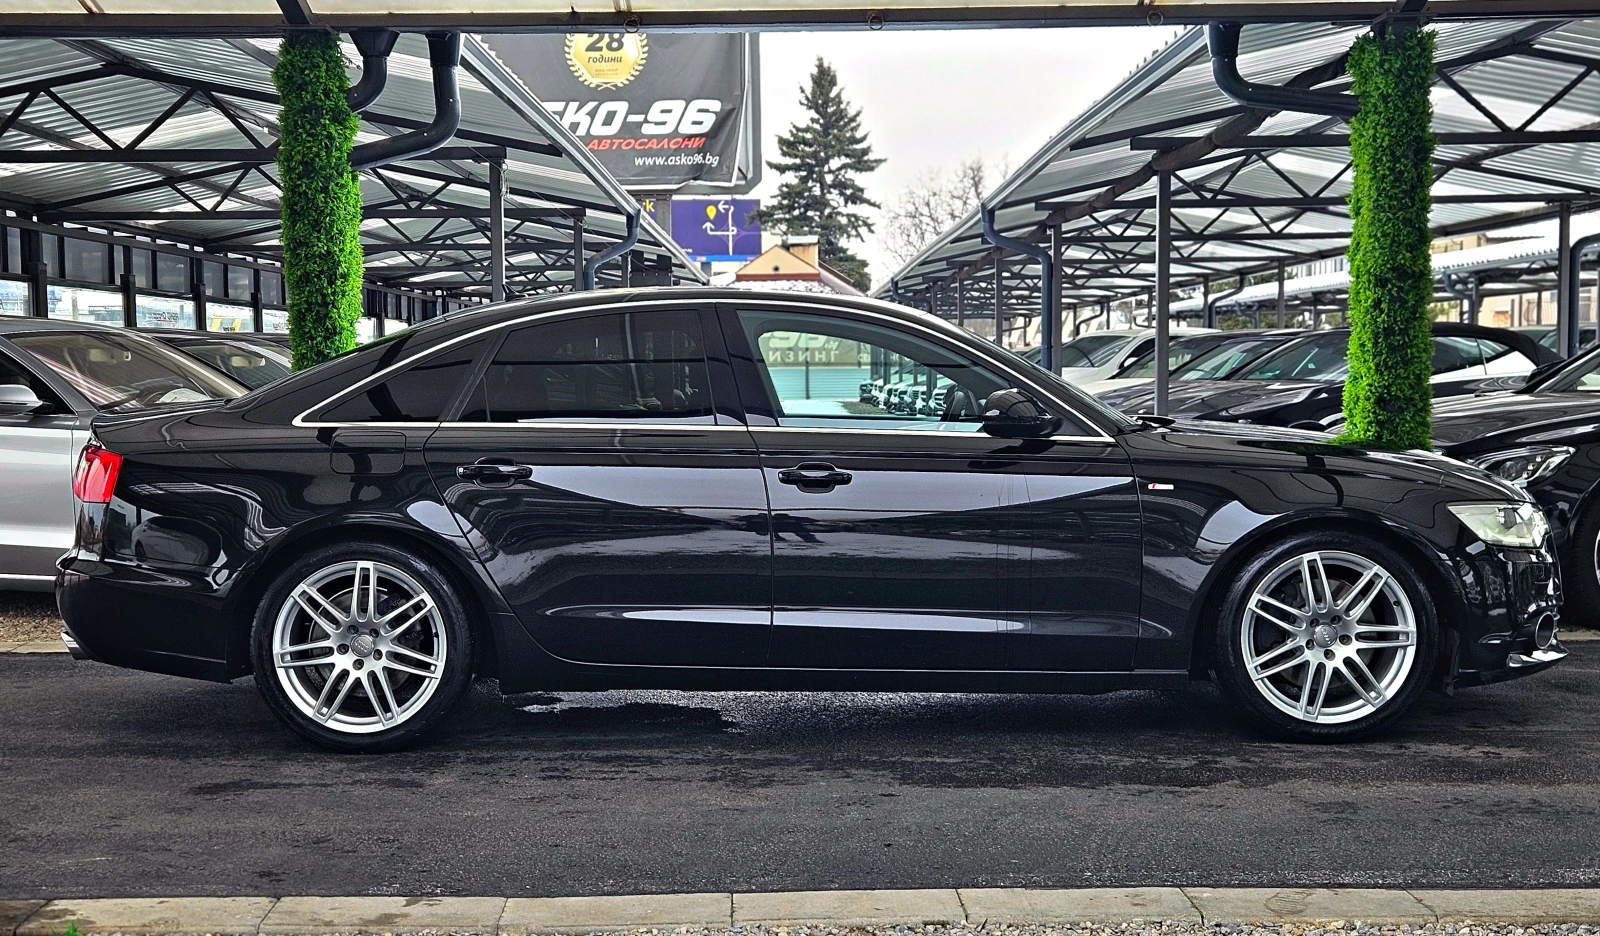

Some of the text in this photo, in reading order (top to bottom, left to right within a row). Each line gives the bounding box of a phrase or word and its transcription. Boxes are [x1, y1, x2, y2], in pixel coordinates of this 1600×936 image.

[585, 33, 625, 52] 28
[587, 54, 623, 63] години
[587, 138, 707, 150] АВТОСАЛОНИ
[634, 152, 719, 167] www.asko96.bg
